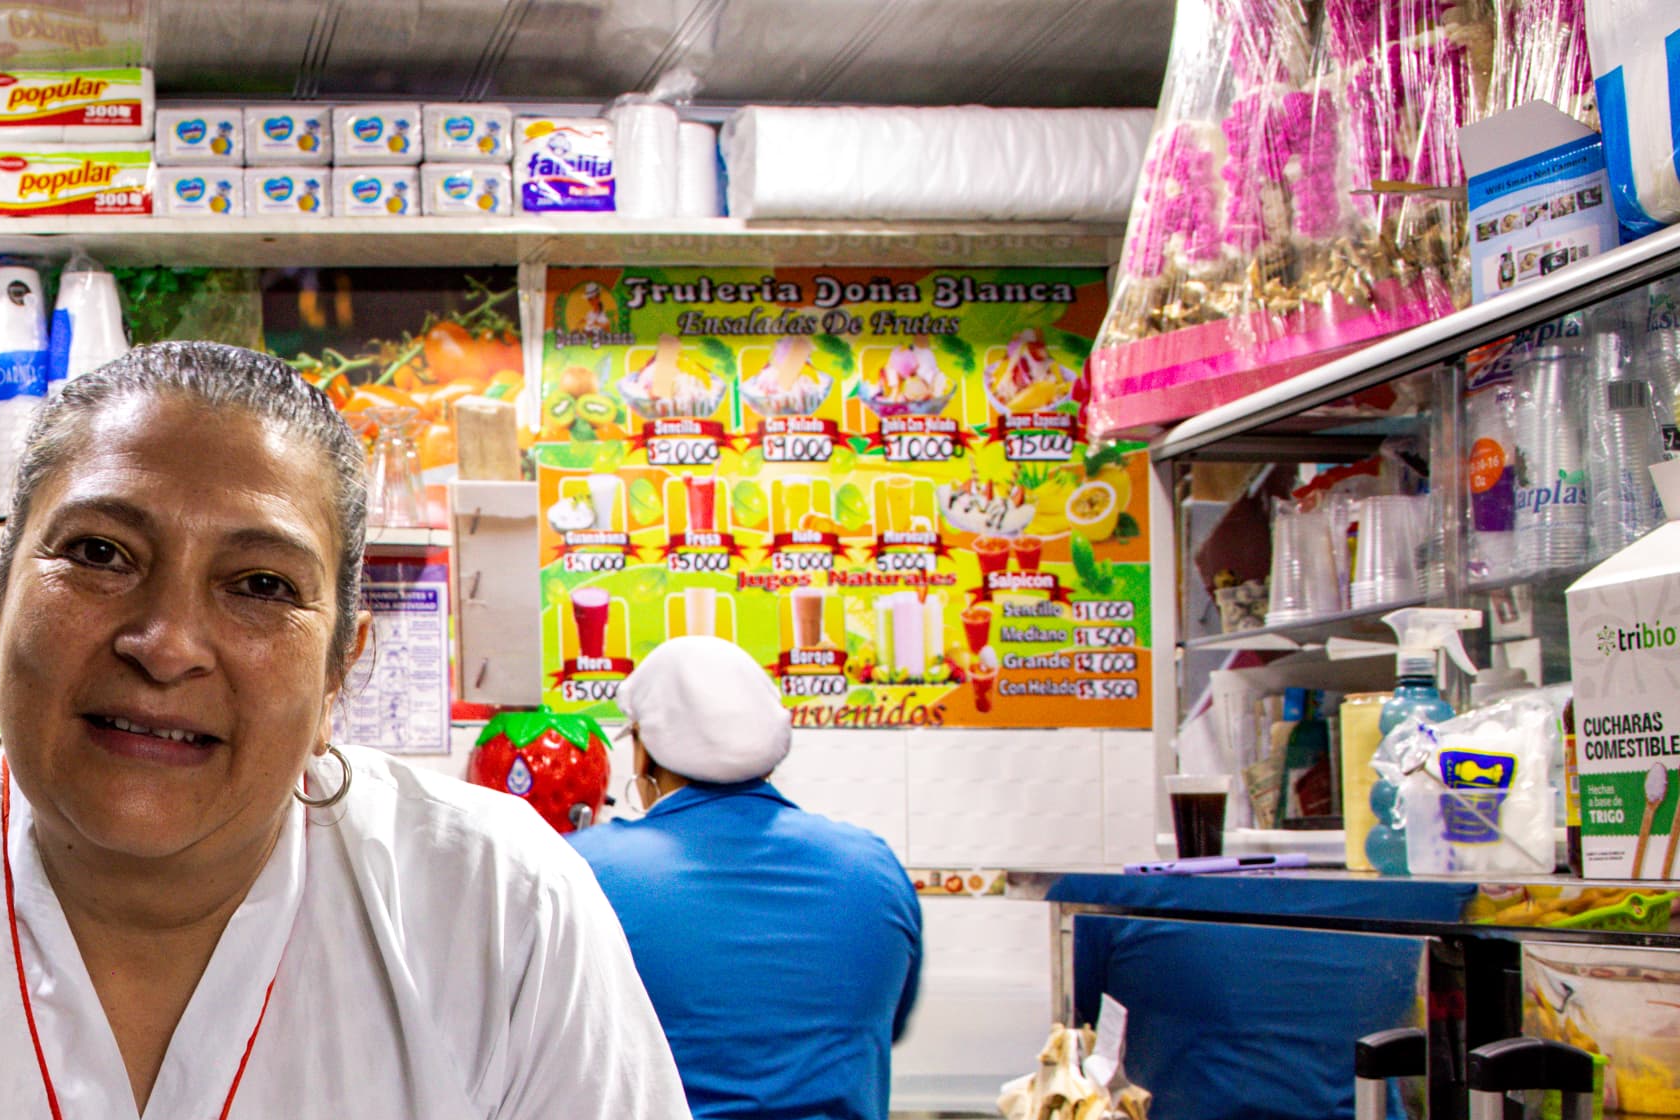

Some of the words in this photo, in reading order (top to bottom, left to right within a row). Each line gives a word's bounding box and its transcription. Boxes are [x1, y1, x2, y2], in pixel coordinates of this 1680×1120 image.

[8, 76, 109, 111] popular
[85, 105, 120, 117] 300
[18, 160, 118, 198] popular
[95, 193, 128, 206] 300
[814, 276, 919, 308] Doña
[932, 276, 1077, 308] Blanca
[676, 309, 818, 336] Ensaladas
[822, 310, 864, 335] De
[871, 309, 961, 336] Frutas
[684, 531, 721, 547] Fresa
[737, 570, 813, 592] Jugos
[827, 569, 958, 587] Naturales
[1003, 600, 1063, 617] Sencillo
[1001, 626, 1067, 643] Mediano
[1618, 620, 1677, 651] tribio
[576, 656, 612, 671] Mora
[790, 650, 835, 665] Borojo
[1003, 652, 1071, 670] Grande
[999, 679, 1026, 695] Con
[1027, 678, 1077, 695] Helado
[1583, 711, 1663, 737] CUCHARAS
[1584, 734, 1680, 761] COMESTIBLE
[1587, 784, 1615, 796] Hechas
[1613, 796, 1623, 807] de
[1589, 809, 1625, 824] TRIGO
